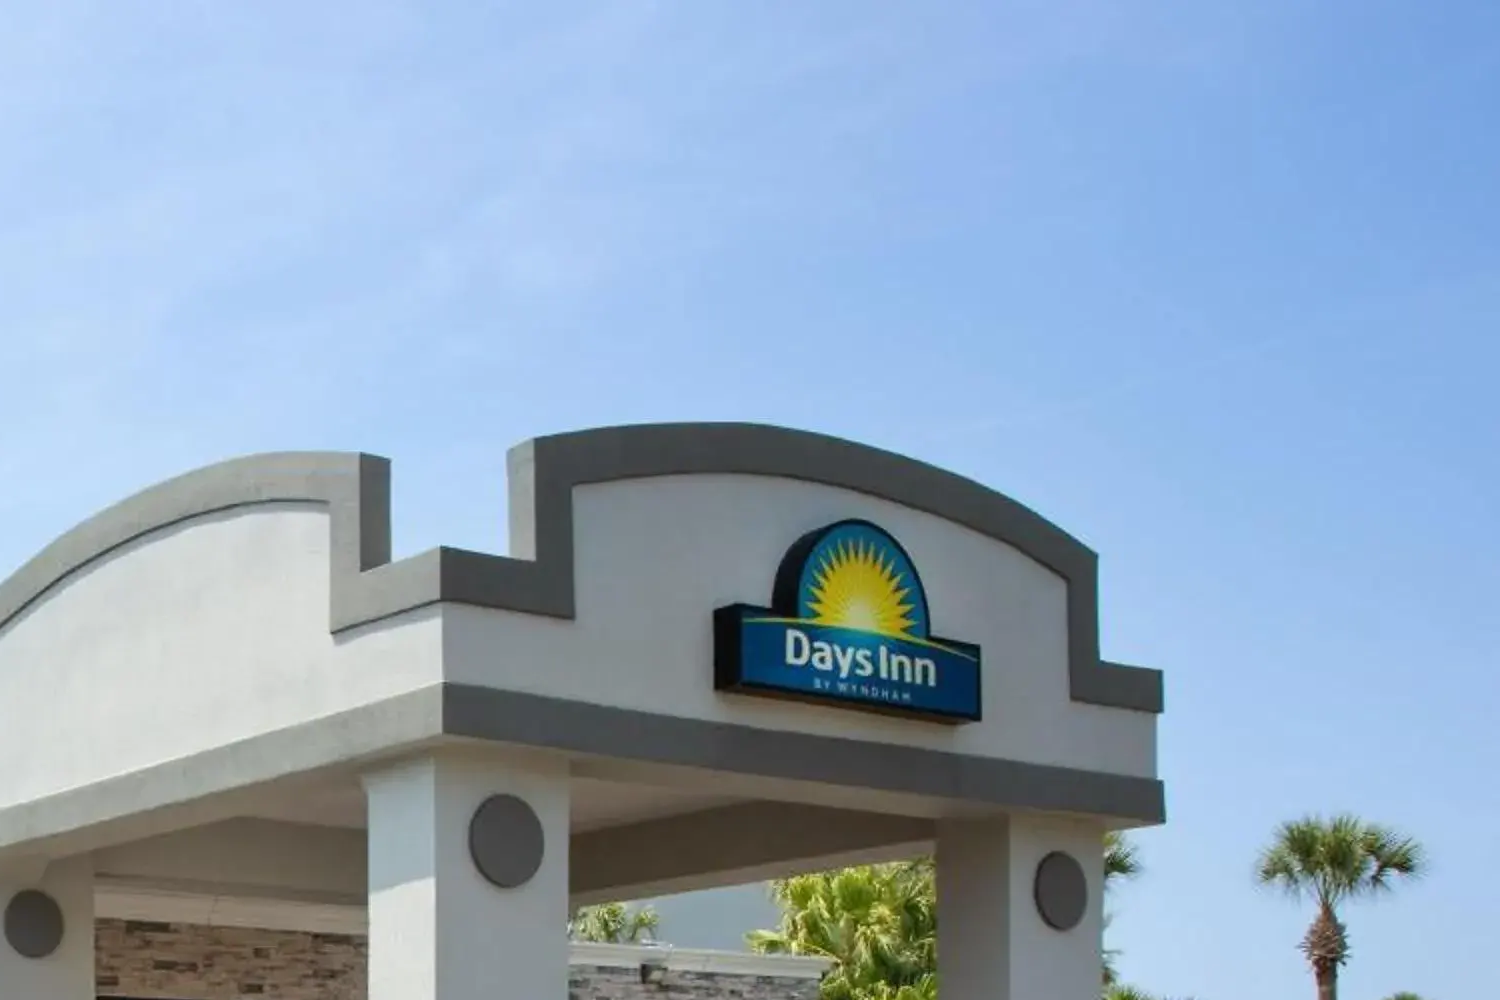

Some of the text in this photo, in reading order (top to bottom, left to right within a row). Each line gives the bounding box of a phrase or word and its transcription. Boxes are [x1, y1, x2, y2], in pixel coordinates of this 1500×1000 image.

[785, 629, 936, 687] Days Inn
[813, 677, 912, 702] BY WYNDHAM
